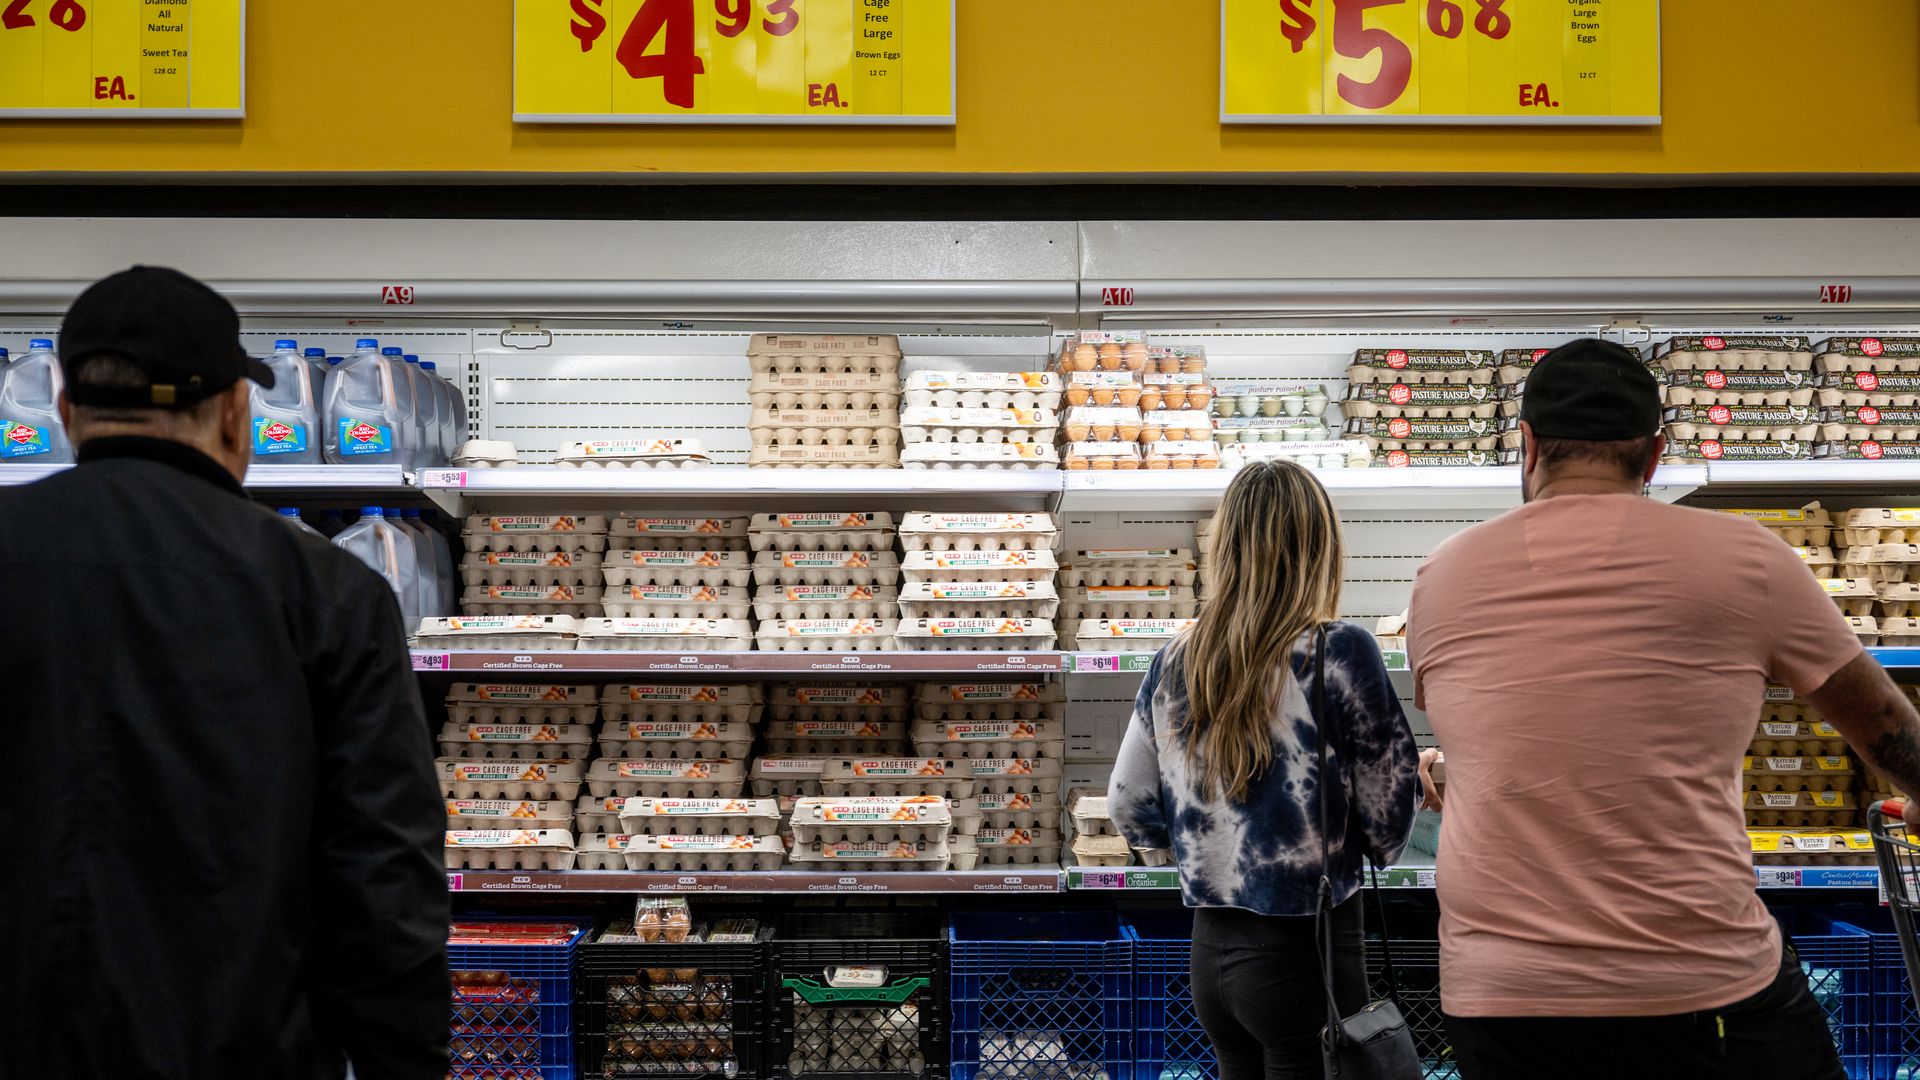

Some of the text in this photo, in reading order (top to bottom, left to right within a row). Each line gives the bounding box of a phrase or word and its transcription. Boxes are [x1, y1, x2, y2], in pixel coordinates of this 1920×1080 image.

[864, 0, 889, 8] Cage
[159, 10, 170, 18] All
[865, 13, 888, 22] Free
[1574, 9, 1597, 18] Large
[148, 24, 183, 32] Natural
[864, 28, 892, 40] Large
[1577, 34, 1597, 44] Eggs
[143, 49, 187, 57] Sweet Tea
[856, 51, 901, 61] Brown Eggs
[95, 76, 135, 100] EA.
[808, 83, 848, 108] EA.
[1519, 84, 1559, 107] EA.
[382, 287, 413, 304] A9
[1102, 288, 1134, 305] A10
[1821, 286, 1851, 303] A11
[813, 341, 829, 350] CAGE
[831, 341, 846, 350] FREE
[1726, 339, 1784, 348] PASTURE-RAISED
[1408, 355, 1466, 364] PASTURE-RAISED
[1727, 376, 1786, 384] PASTURE-RAISED
[1411, 390, 1470, 398] PASTURE-RAISED
[1731, 411, 1791, 420] PASTURE-RAISED
[1411, 425, 1470, 433] PASTURE-RAISED
[1724, 447, 1782, 455] PASTURE-RAISED
[1410, 457, 1468, 466] PASTURE-RAISED
[516, 516, 550, 524] CAGE FREE
[656, 687, 692, 695] CAGE FREE
[977, 685, 995, 693] CAGE
[495, 726, 532, 734] CAGE FREE
[881, 761, 899, 769] CAGE
[852, 806, 890, 814] CAGE FREE
[1127, 878, 1158, 887] Organics
